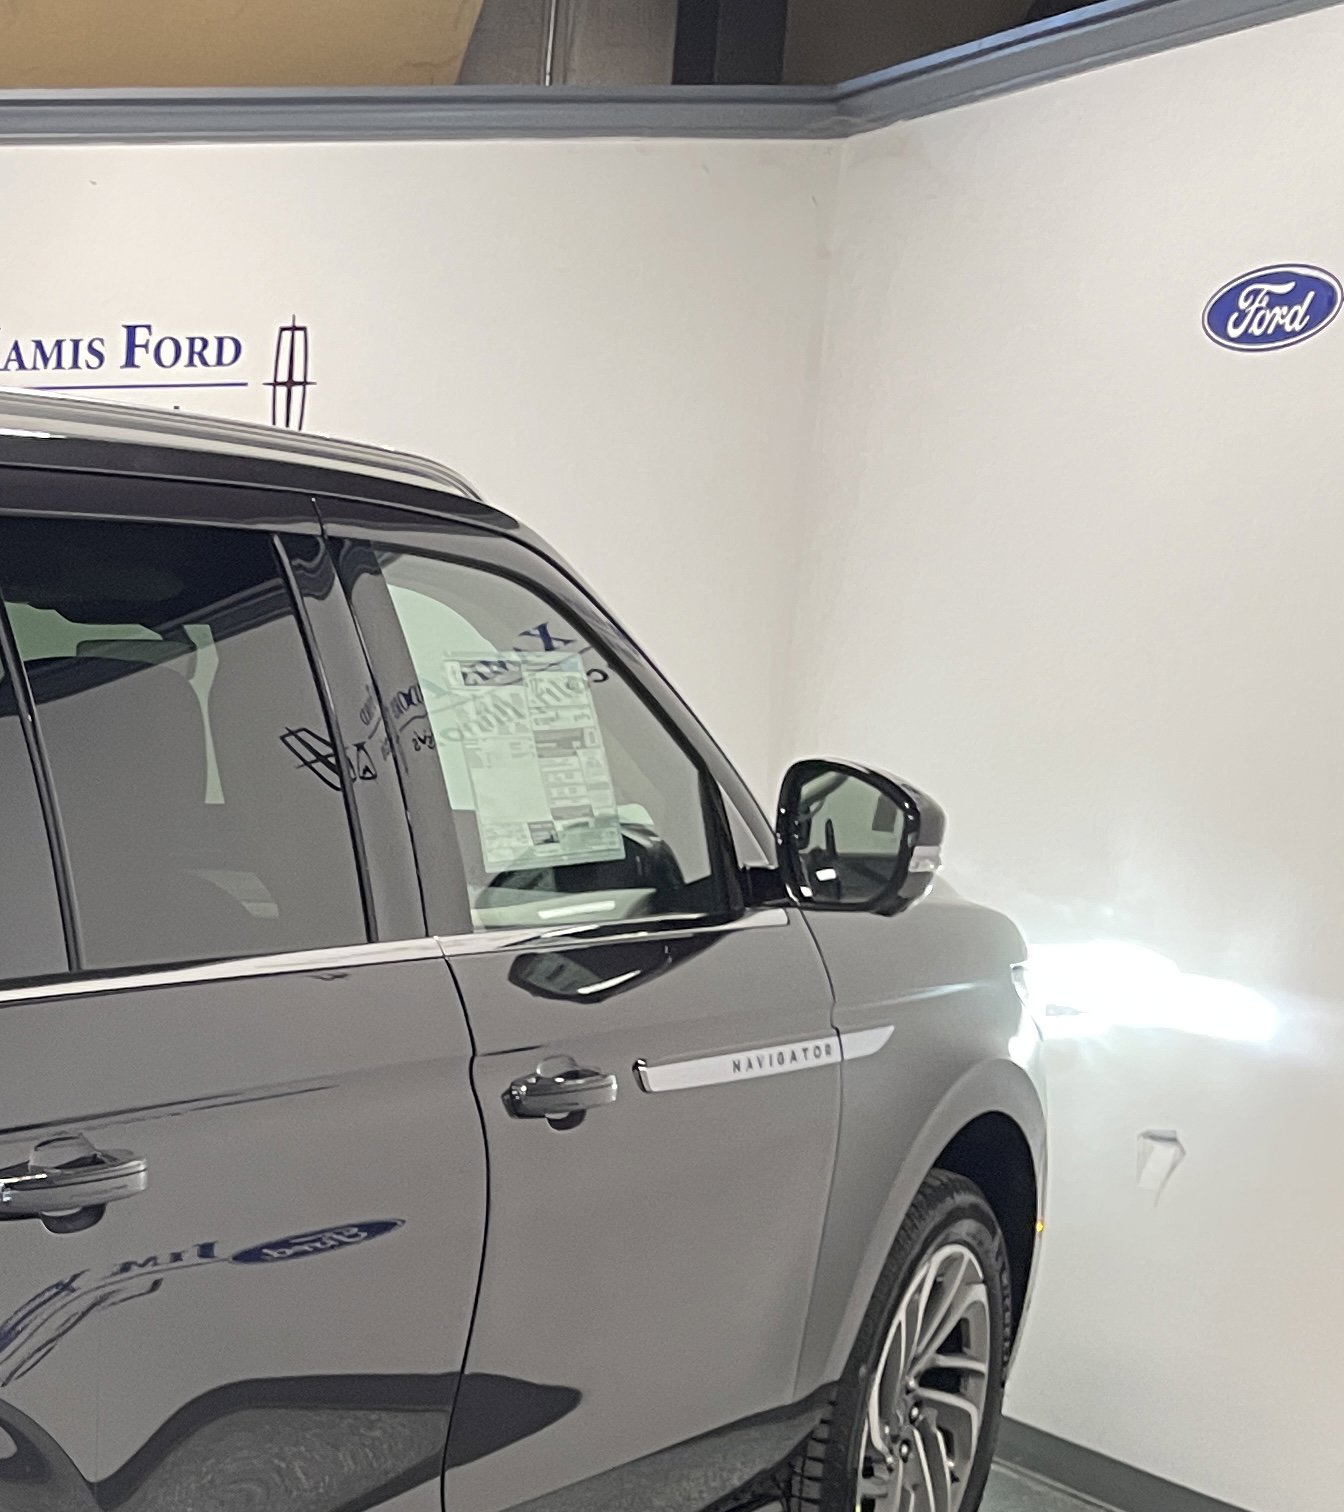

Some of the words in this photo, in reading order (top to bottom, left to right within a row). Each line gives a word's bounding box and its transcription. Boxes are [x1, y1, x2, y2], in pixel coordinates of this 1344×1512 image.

[1226, 280, 1315, 339] Ford
[119, 323, 243, 369] FORD
[732, 1043, 832, 1074] NAVIGATOR
